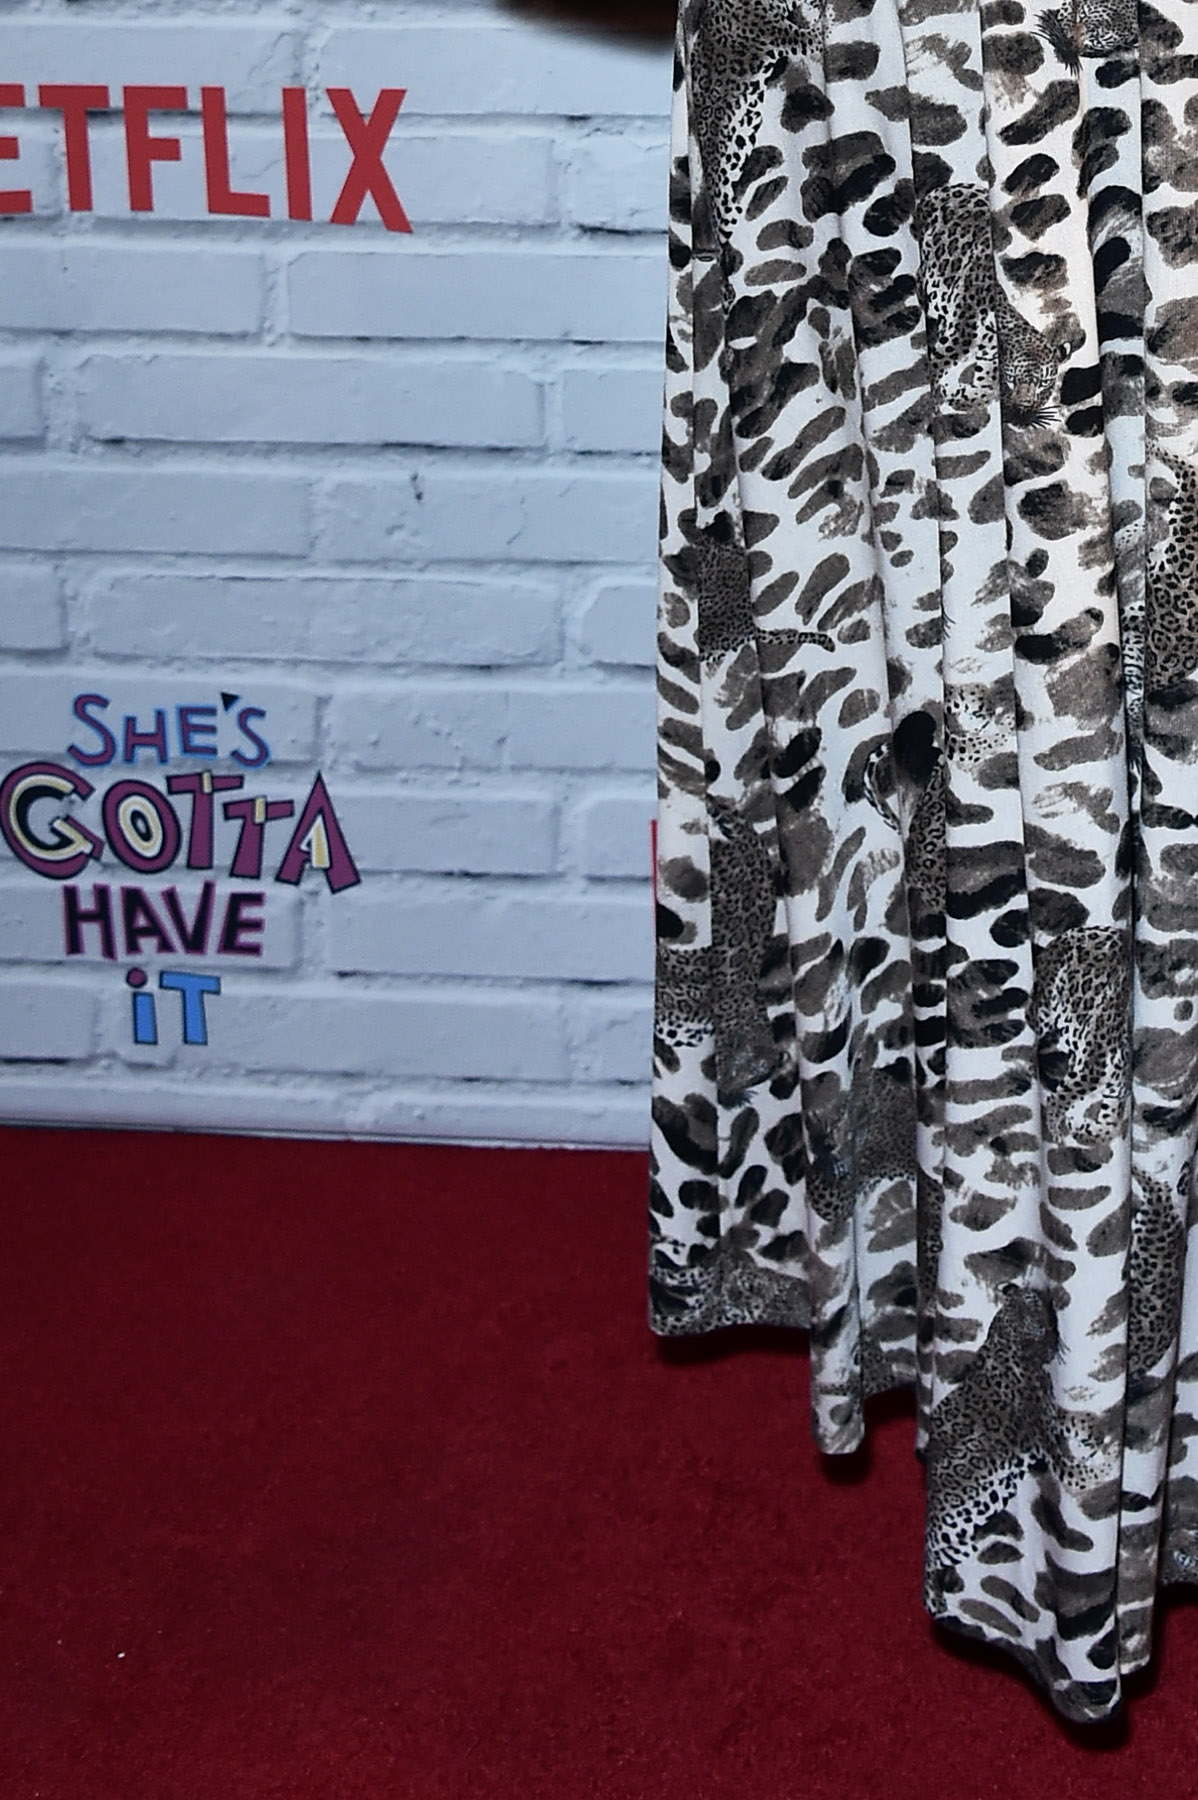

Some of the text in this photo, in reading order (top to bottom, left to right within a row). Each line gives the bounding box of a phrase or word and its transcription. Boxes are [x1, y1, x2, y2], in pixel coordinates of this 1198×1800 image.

[66, 691, 272, 769] SHE'S
[0, 761, 362, 895] GOTTA
[61, 880, 266, 962] HAVE
